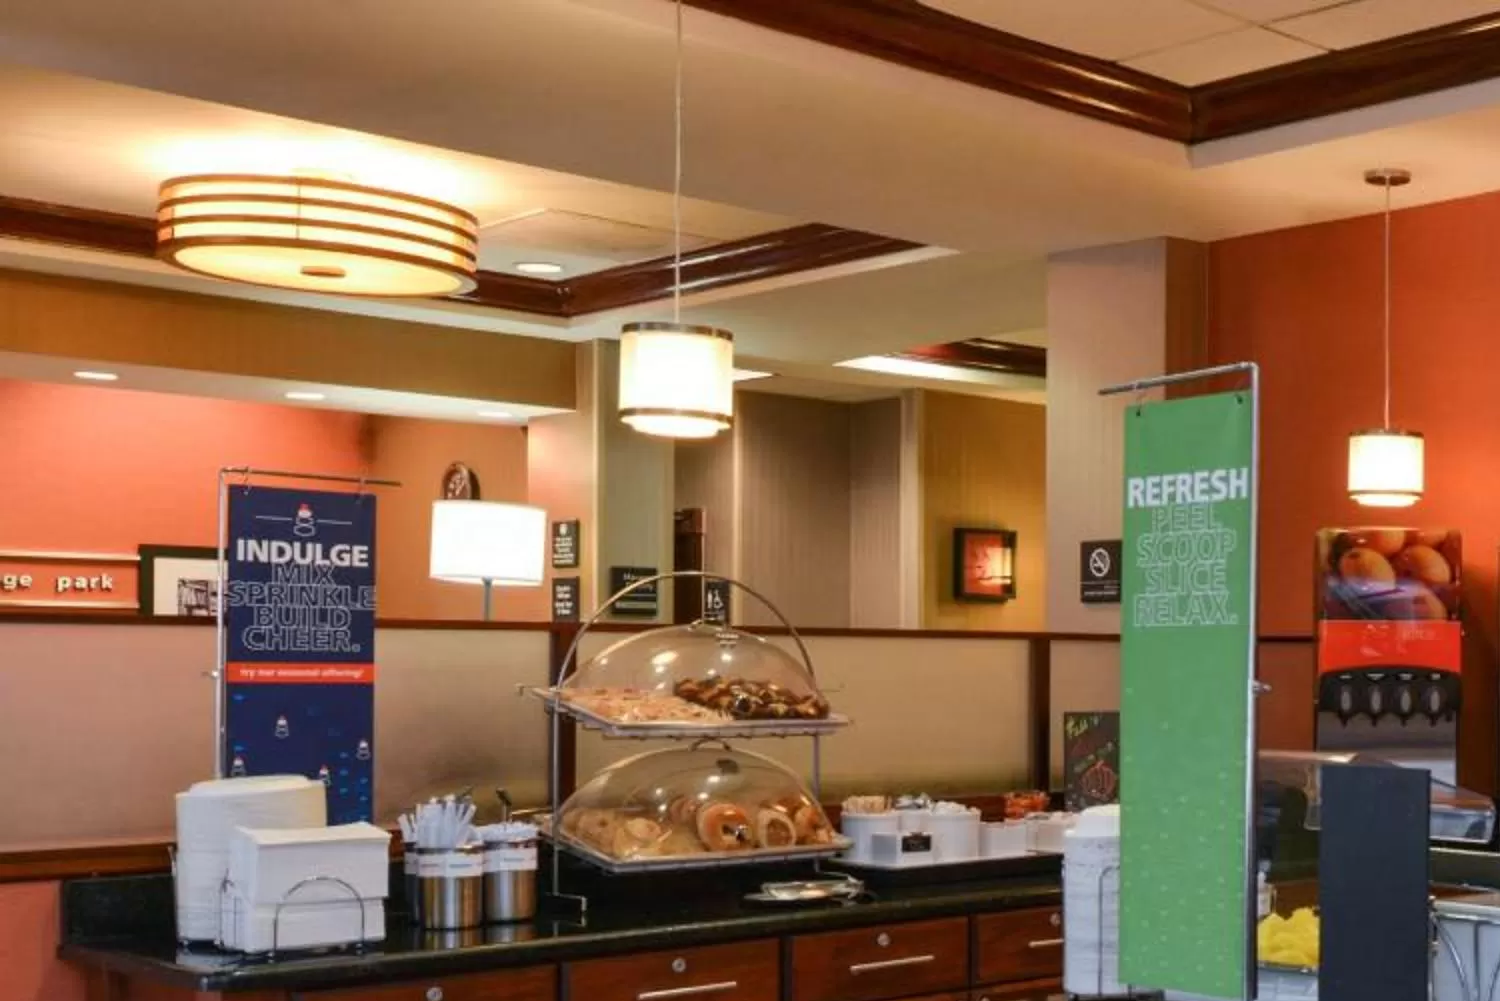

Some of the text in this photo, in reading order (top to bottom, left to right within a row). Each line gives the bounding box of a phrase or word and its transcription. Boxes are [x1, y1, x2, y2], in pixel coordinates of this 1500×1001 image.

[1127, 467, 1249, 508] REFRESH
[1151, 501, 1222, 534] PEEL
[236, 538, 369, 567] INDULGE
[1136, 527, 1237, 568] SCOOP
[57, 573, 113, 593] park
[271, 561, 336, 588] MIX
[1145, 560, 1227, 595] SLICE
[228, 580, 377, 610] SPRINKLE
[252, 604, 352, 631] BUILD
[242, 624, 361, 653] CHEER.
